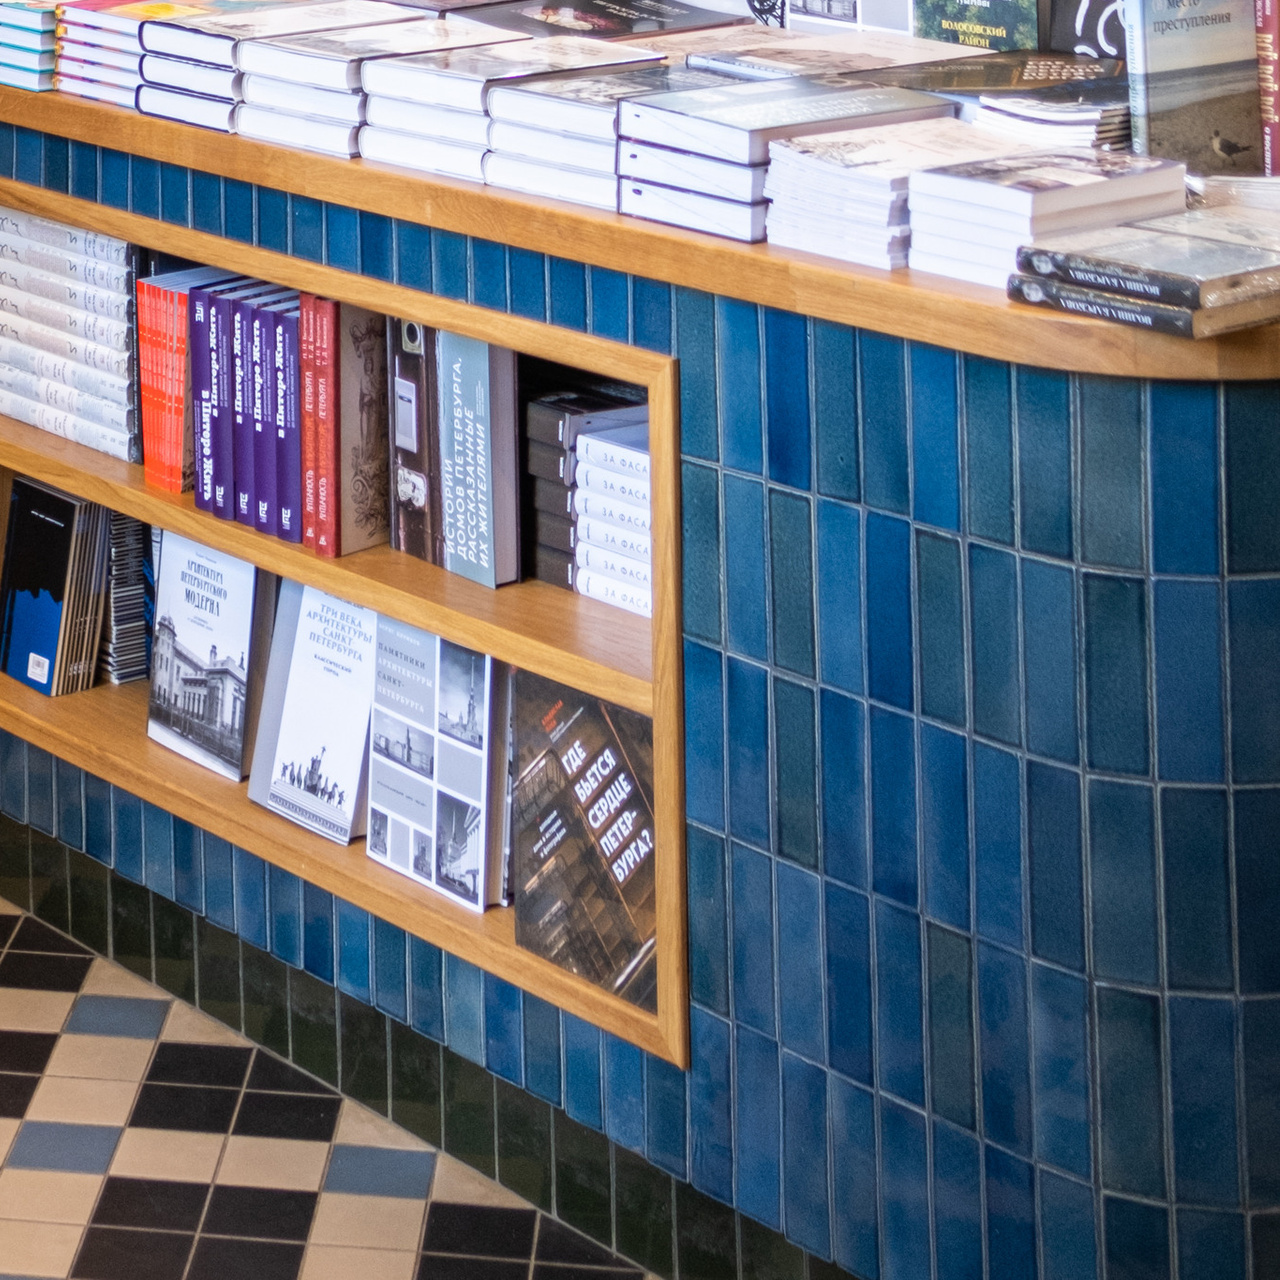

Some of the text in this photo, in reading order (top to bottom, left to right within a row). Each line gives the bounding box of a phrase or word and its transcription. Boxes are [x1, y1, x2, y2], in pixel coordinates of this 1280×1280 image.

[941, 20, 1007, 38] ВОЛОСОВСКИЙ
[1153, 11, 1232, 35] преступления
[958, 35, 990, 48] РАЙОН
[209, 306, 217, 357] Жить
[233, 312, 241, 361] Жить
[275, 325, 283, 375] Жить
[210, 358, 219, 409] Питере
[234, 364, 243, 414] Питере
[254, 372, 263, 422] Питере
[276, 378, 286, 427] Питере
[201, 401, 212, 456] Питере
[452, 358, 468, 560] ДОМОВ ПЕТЕРБУРГА,
[604, 452, 615, 464] ЗА
[203, 458, 214, 501] Жить
[464, 408, 478, 564] РАССКАЗАННЫЕ
[476, 422, 488, 569] ИХ ЖИТЕЛЯМИ
[604, 480, 615, 490] ЗА
[319, 477, 327, 521] АНТИЧНОСТЬ
[443, 459, 454, 555] ИСТОРИИ
[602, 507, 614, 518] ЗА
[605, 533, 616, 544] ЗА
[188, 560, 223, 585] АРХИТЕКТУРА
[604, 560, 615, 571] ЗА
[181, 571, 227, 601] ПЕТЕРБУРГСКОГО
[185, 588, 220, 617] МОДЕРНА
[605, 587, 616, 598] ЗА
[307, 610, 372, 643] АРХИТЕКТУРЫ
[321, 604, 362, 629] ТРИ ВЕКА
[309, 632, 362, 662] ПЕТЕРБУРГА
[314, 654, 352, 673] КЛАССИЧЕСКИЙ
[378, 642, 425, 670] ПАМЯТНИКИ
[377, 670, 405, 688] САНКТ-
[378, 657, 433, 688] АРХИТЕКТУРЫ
[377, 684, 424, 714] ПЕТЕРБУРГА
[561, 740, 587, 775] ГДЕ
[574, 748, 616, 803] БЬЕТСЯ
[587, 773, 632, 829] СЕРДЦЕ
[599, 809, 638, 858] ПЕТЕР-
[611, 829, 654, 883] БУРГА?
